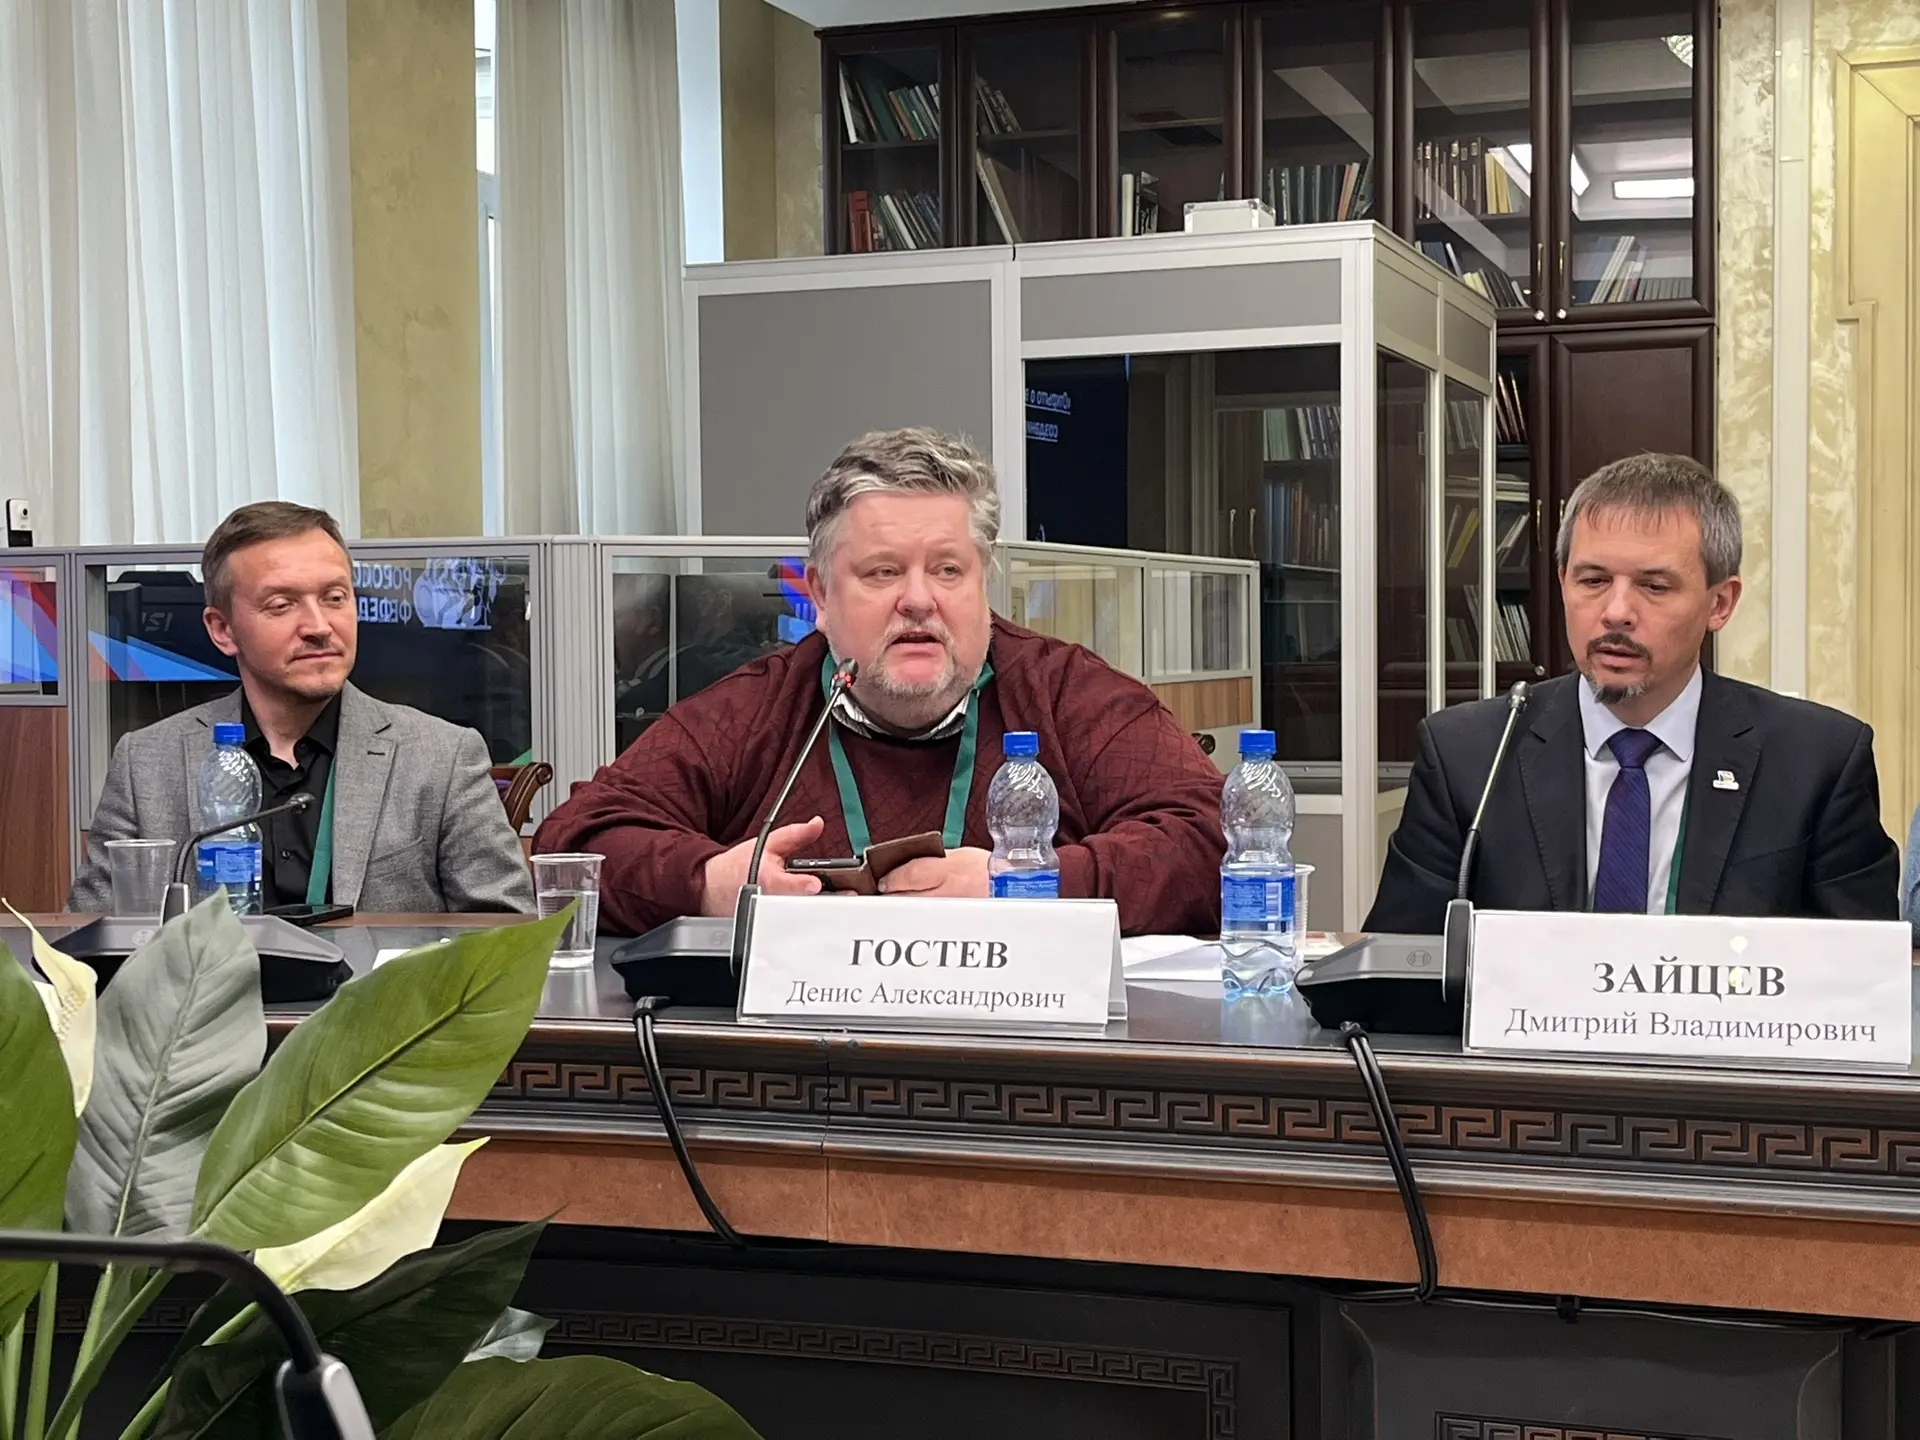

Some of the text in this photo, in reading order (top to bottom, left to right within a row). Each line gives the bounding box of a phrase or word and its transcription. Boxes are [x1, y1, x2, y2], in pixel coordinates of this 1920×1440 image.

[848, 939, 1008, 969] ГОСТЕВ
[786, 980, 1066, 1012] Денис Александрович
[1592, 955, 1786, 1002] ЗАЙЦЕВ
[1504, 1008, 1876, 1047] Дмитрий Владимирович
